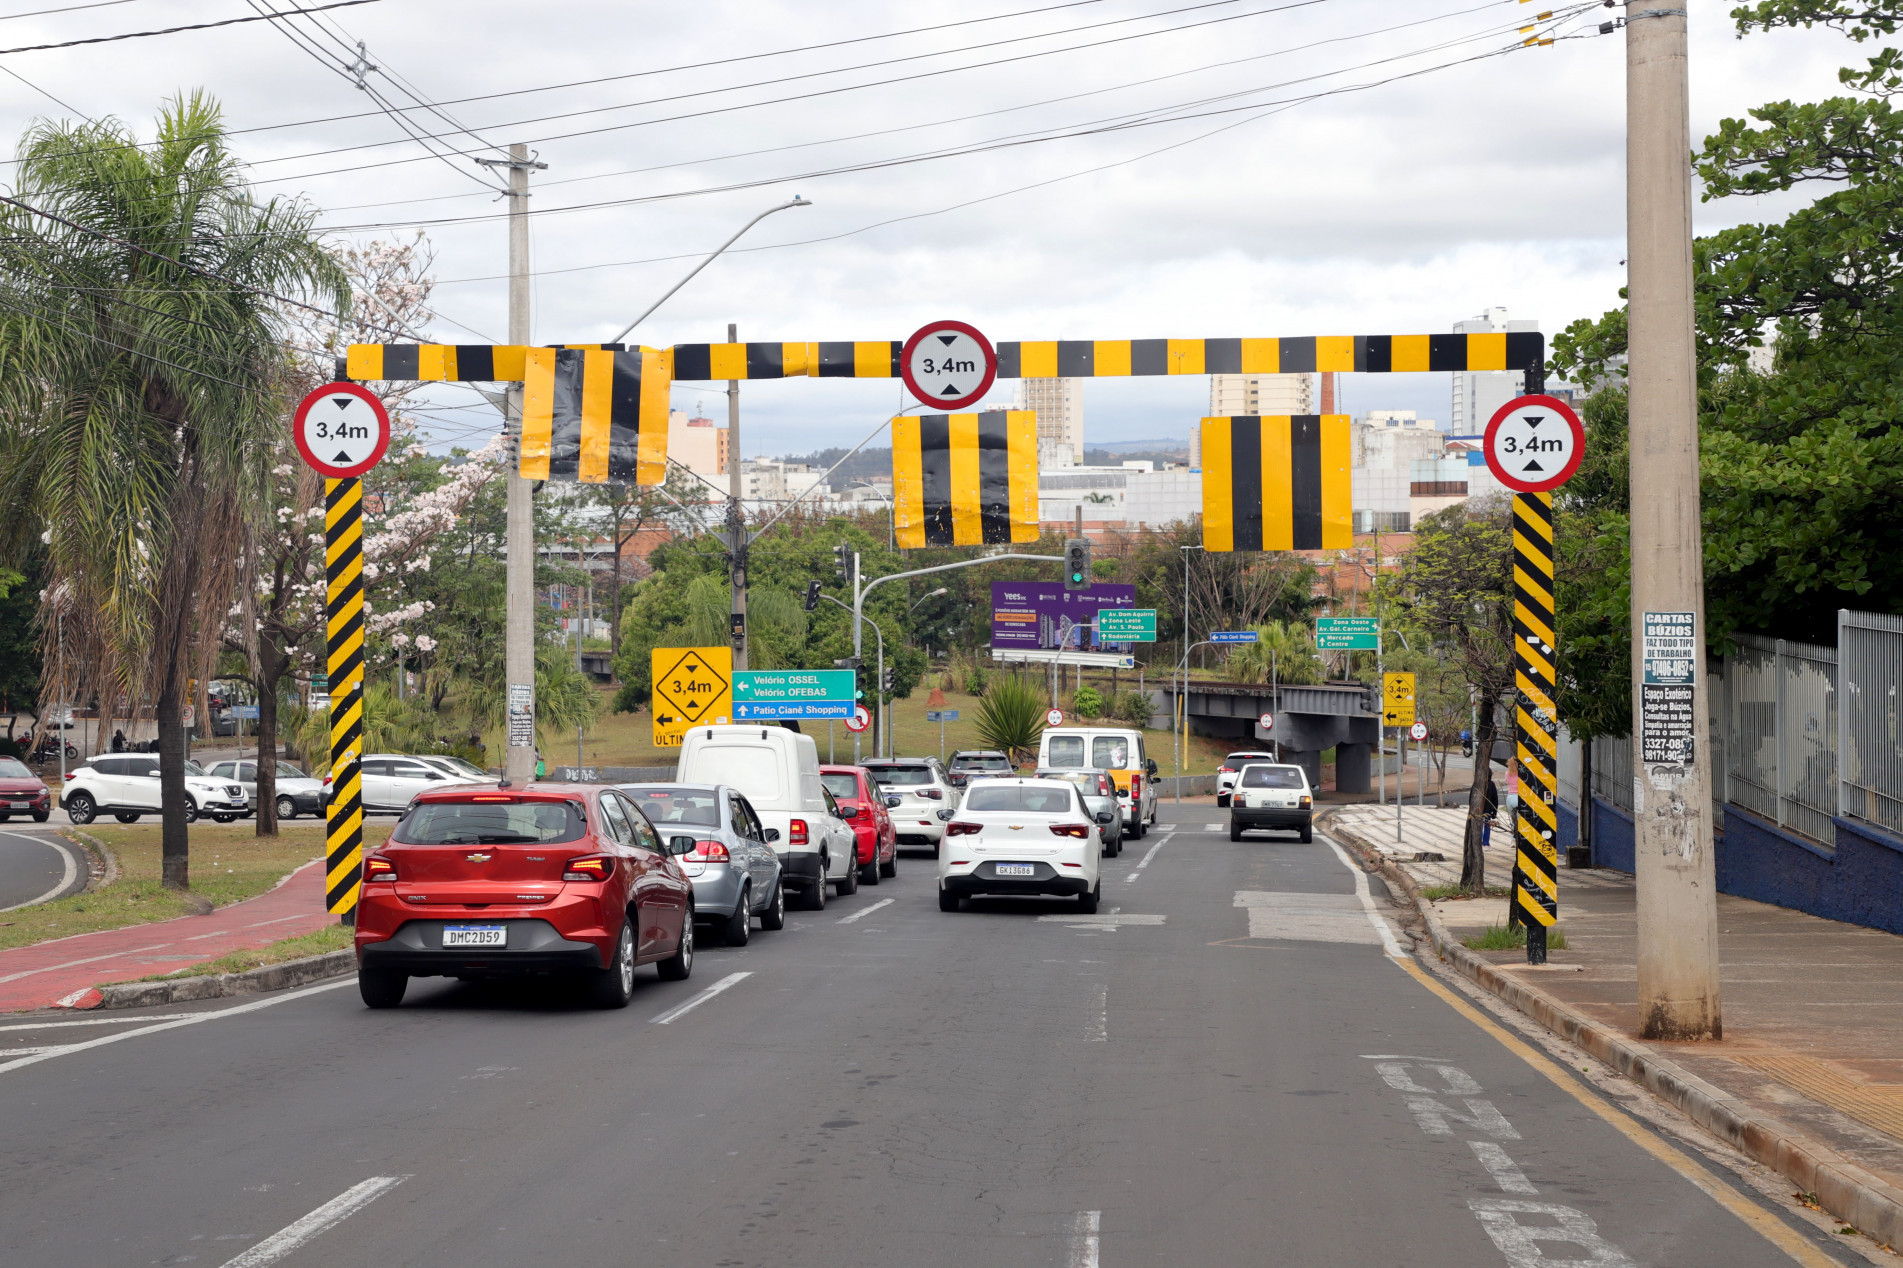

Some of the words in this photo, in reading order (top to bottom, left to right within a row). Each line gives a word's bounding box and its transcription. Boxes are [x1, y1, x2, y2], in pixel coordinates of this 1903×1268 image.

[923, 358, 975, 376] 3,4m
[316, 422, 368, 441] 3,4m
[1504, 436, 1563, 455] 3,4m
[1646, 614, 1692, 623] CARTAS
[1647, 624, 1692, 636] BÚZIOS
[1646, 638, 1657, 647] FAZ
[1658, 638, 1678, 647] TODO
[1679, 638, 1694, 647] TIPO
[1647, 649, 1655, 658] DE
[1656, 649, 1692, 658] TRABALHO
[1645, 663, 1652, 671] 15
[754, 676, 785, 684] Velório
[788, 676, 820, 684] OSSEL
[673, 680, 712, 695] 3,4m
[754, 688, 785, 696] Velório
[788, 688, 827, 696] OFEBAS
[1644, 687, 1664, 702] Espaço
[1664, 687, 1692, 700] Exotérico
[753, 706, 776, 714] Patio
[778, 705, 803, 714] Cianê
[805, 705, 847, 716] Shopping
[1644, 702, 1668, 712] Joga-se
[1644, 712, 1670, 720] Consultas
[1678, 711, 1692, 722] Água
[1645, 721, 1663, 729] Simpatia
[1668, 721, 1692, 730] amarração
[449, 931, 500, 944] DMC2D59
